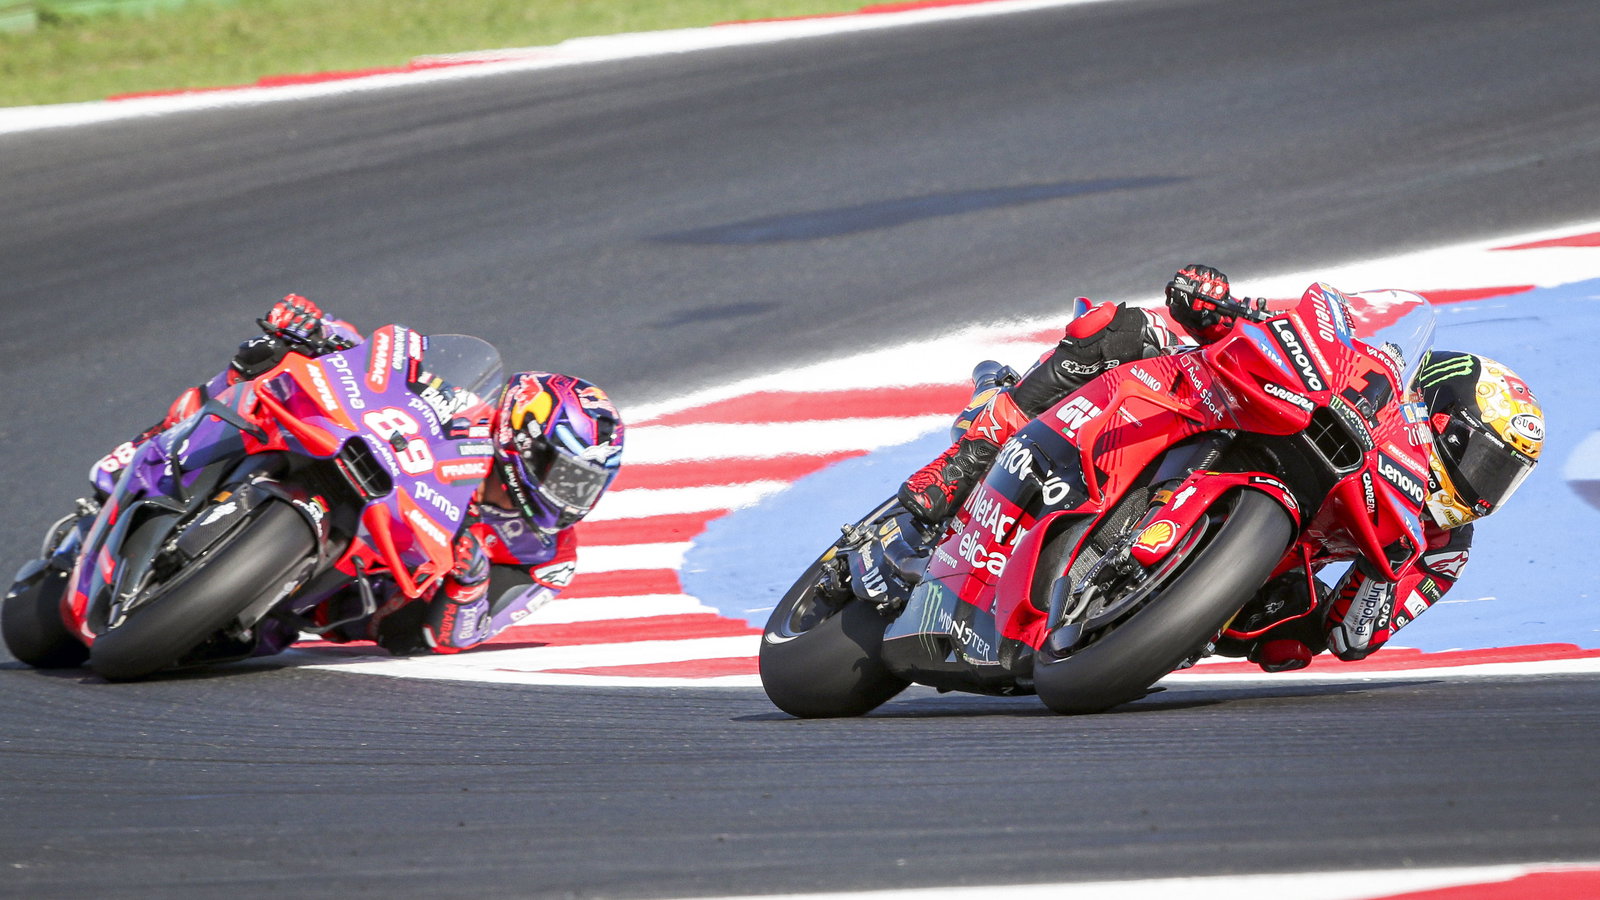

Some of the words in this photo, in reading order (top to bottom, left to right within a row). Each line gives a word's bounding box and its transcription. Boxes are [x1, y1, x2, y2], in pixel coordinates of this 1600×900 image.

[371, 332, 390, 385] PRAMAC
[1260, 343, 1283, 367] TIM
[1272, 319, 1322, 391] Lenovo
[1366, 345, 1404, 392] VARGROUP
[306, 362, 339, 412] MOTUL
[327, 357, 366, 410] prima
[1136, 368, 1162, 392] DAIKO
[1187, 367, 1202, 391] Audi
[1200, 389, 1225, 421] Sport
[1263, 382, 1315, 411] CARRERA
[408, 397, 440, 437] prima
[1342, 405, 1374, 451] MONSTER
[362, 407, 434, 477] 89
[414, 481, 461, 522] prima
[1363, 472, 1376, 514] CARRERA
[1377, 454, 1424, 502] Lenovo
[958, 530, 1007, 577] elica
[437, 604, 457, 645] PRAMAC
[1355, 581, 1386, 636] UnipolSai
[938, 608, 991, 662] MONSTER
